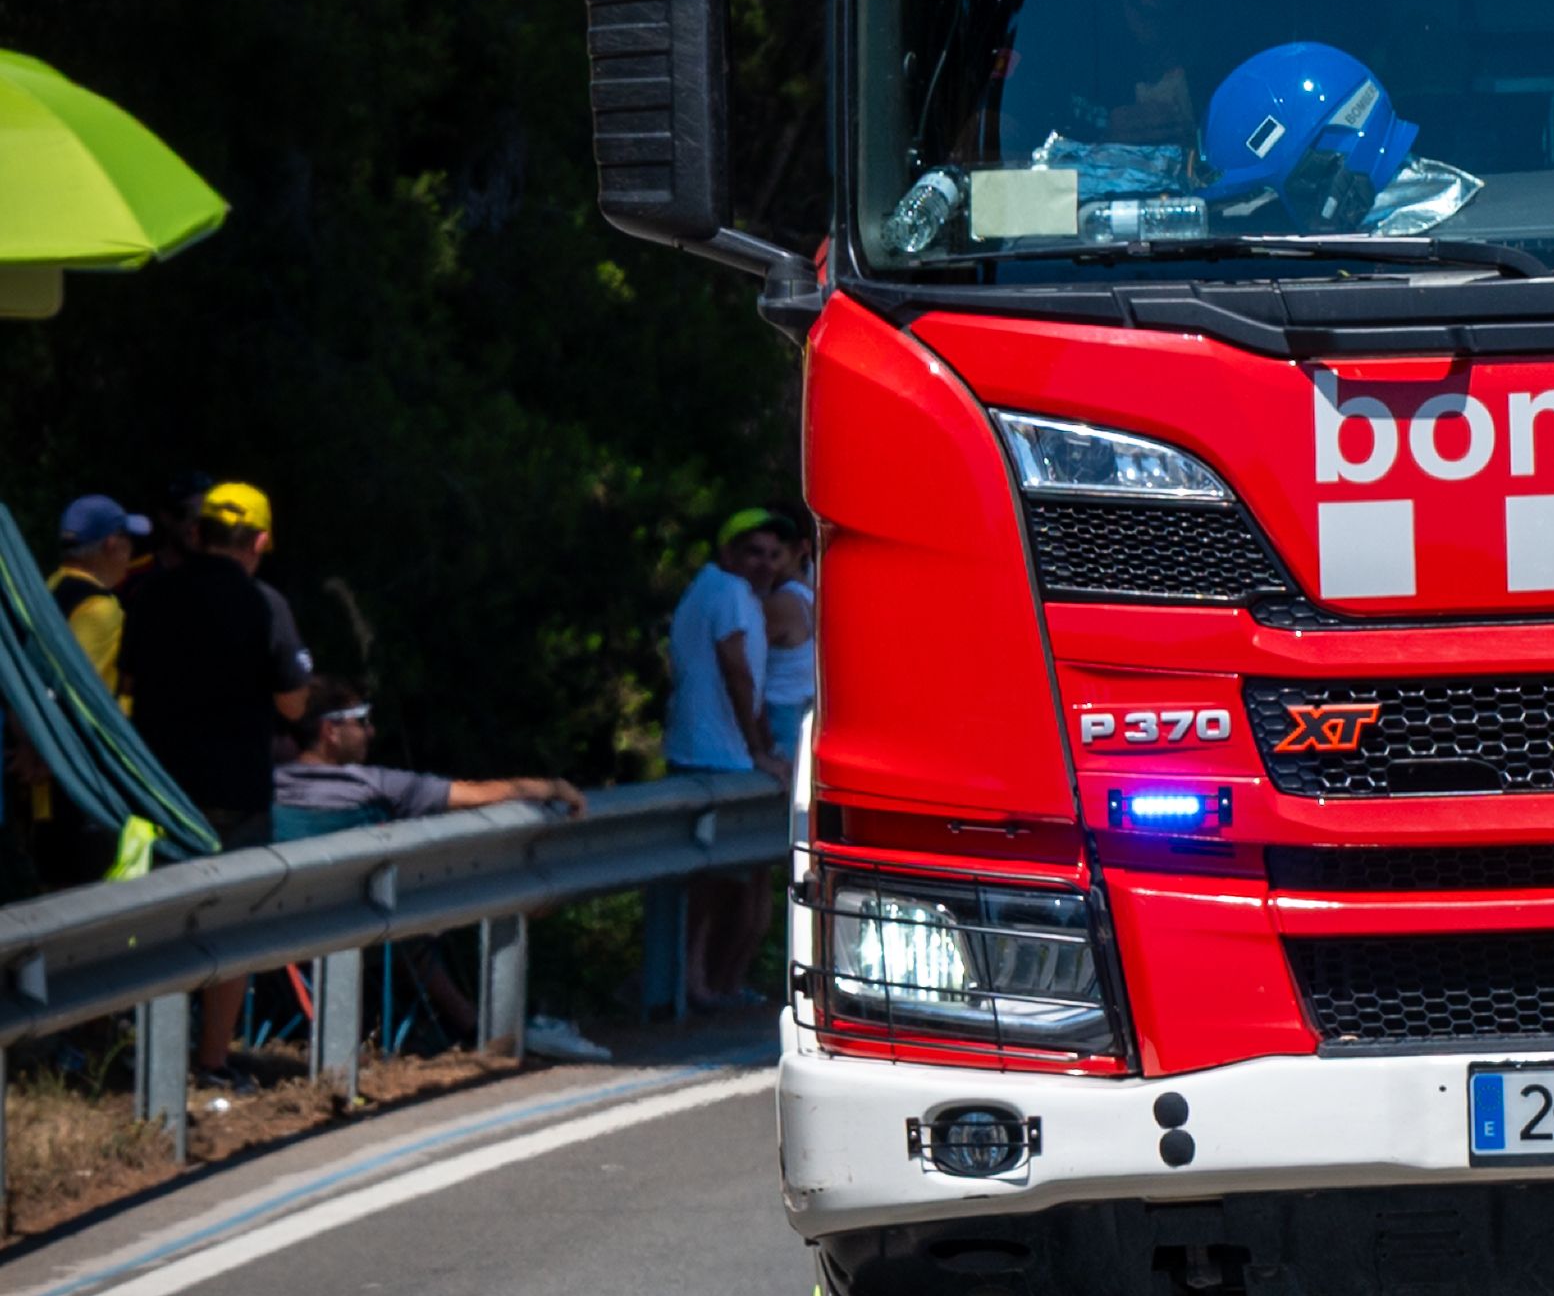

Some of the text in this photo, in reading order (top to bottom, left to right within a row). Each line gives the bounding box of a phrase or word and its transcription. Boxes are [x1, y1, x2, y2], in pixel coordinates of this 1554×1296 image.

[1081, 709, 1231, 744] P 370
[1274, 703, 1382, 752] XT
[1484, 1120, 1495, 1137] E
